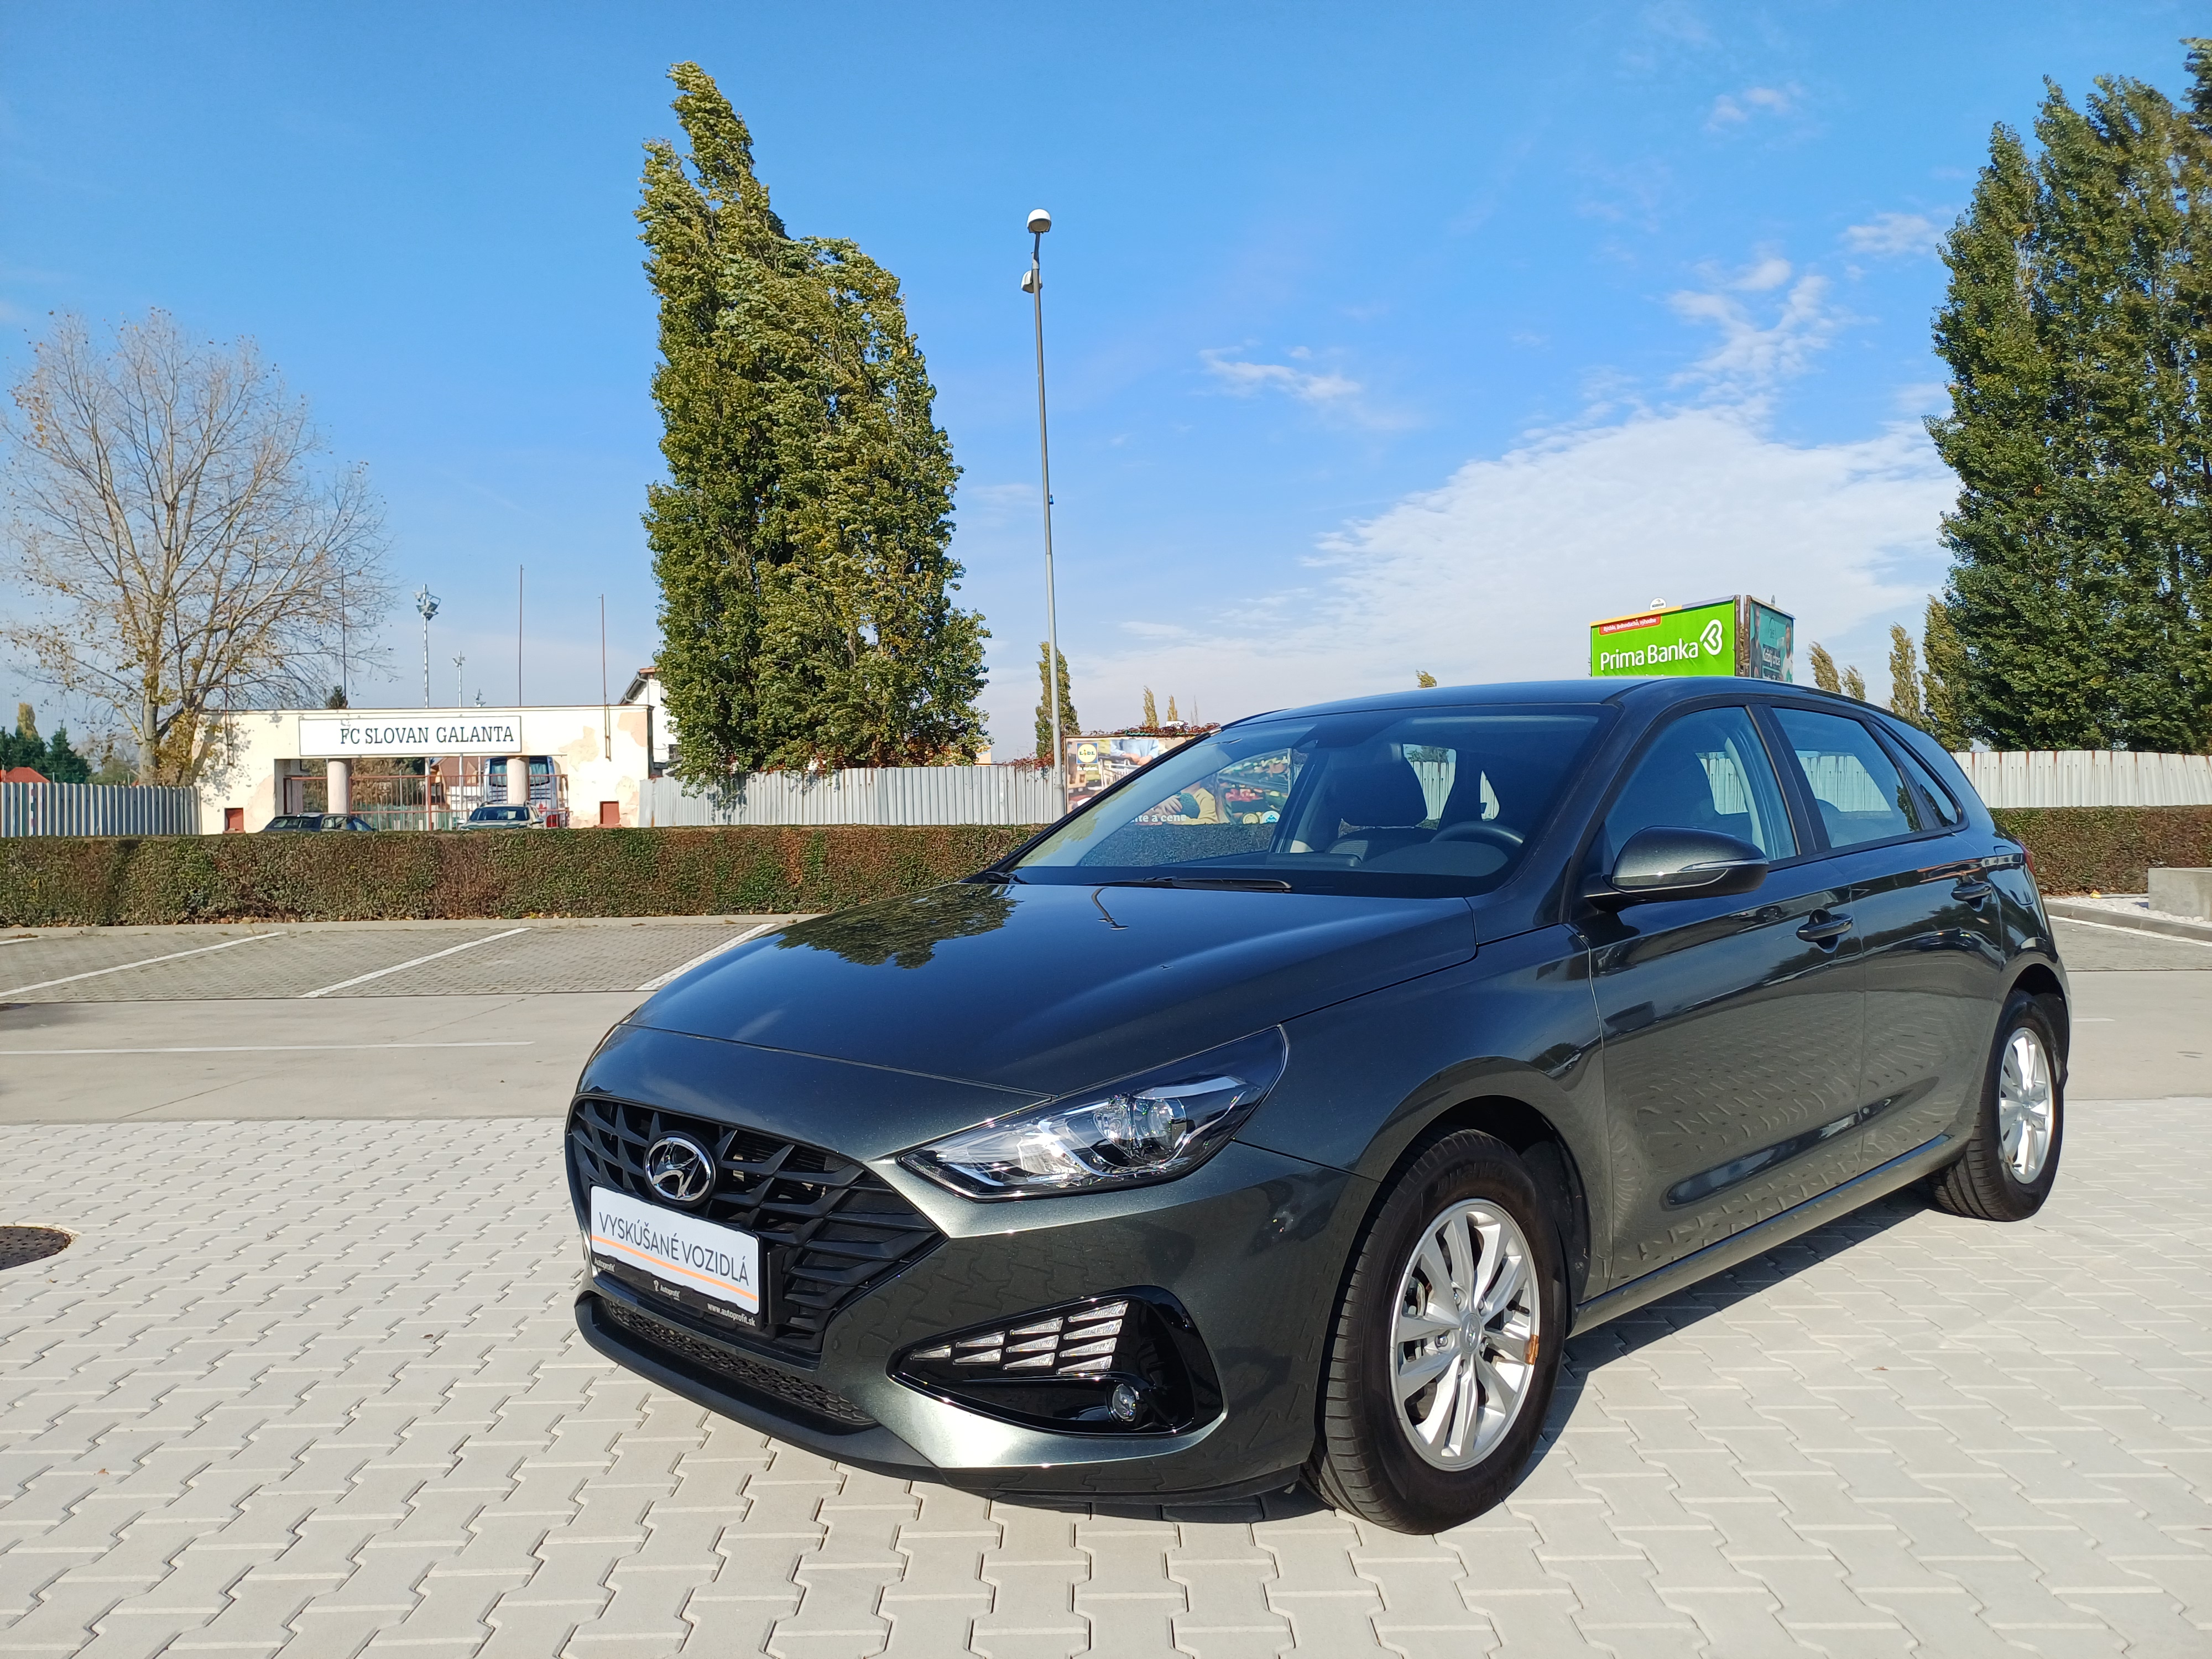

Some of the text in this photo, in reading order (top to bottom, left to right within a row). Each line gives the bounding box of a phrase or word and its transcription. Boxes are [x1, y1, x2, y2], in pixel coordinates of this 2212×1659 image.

[1600, 638, 1698, 671] Prima Banka
[341, 726, 514, 744] FC SLOVAN GALANTA
[1160, 814, 1187, 822] cene
[598, 1212, 749, 1286] VYSKÚŠANÉ VOZIDLÁ
[707, 1303, 756, 1327] www.autoprofit.sk
